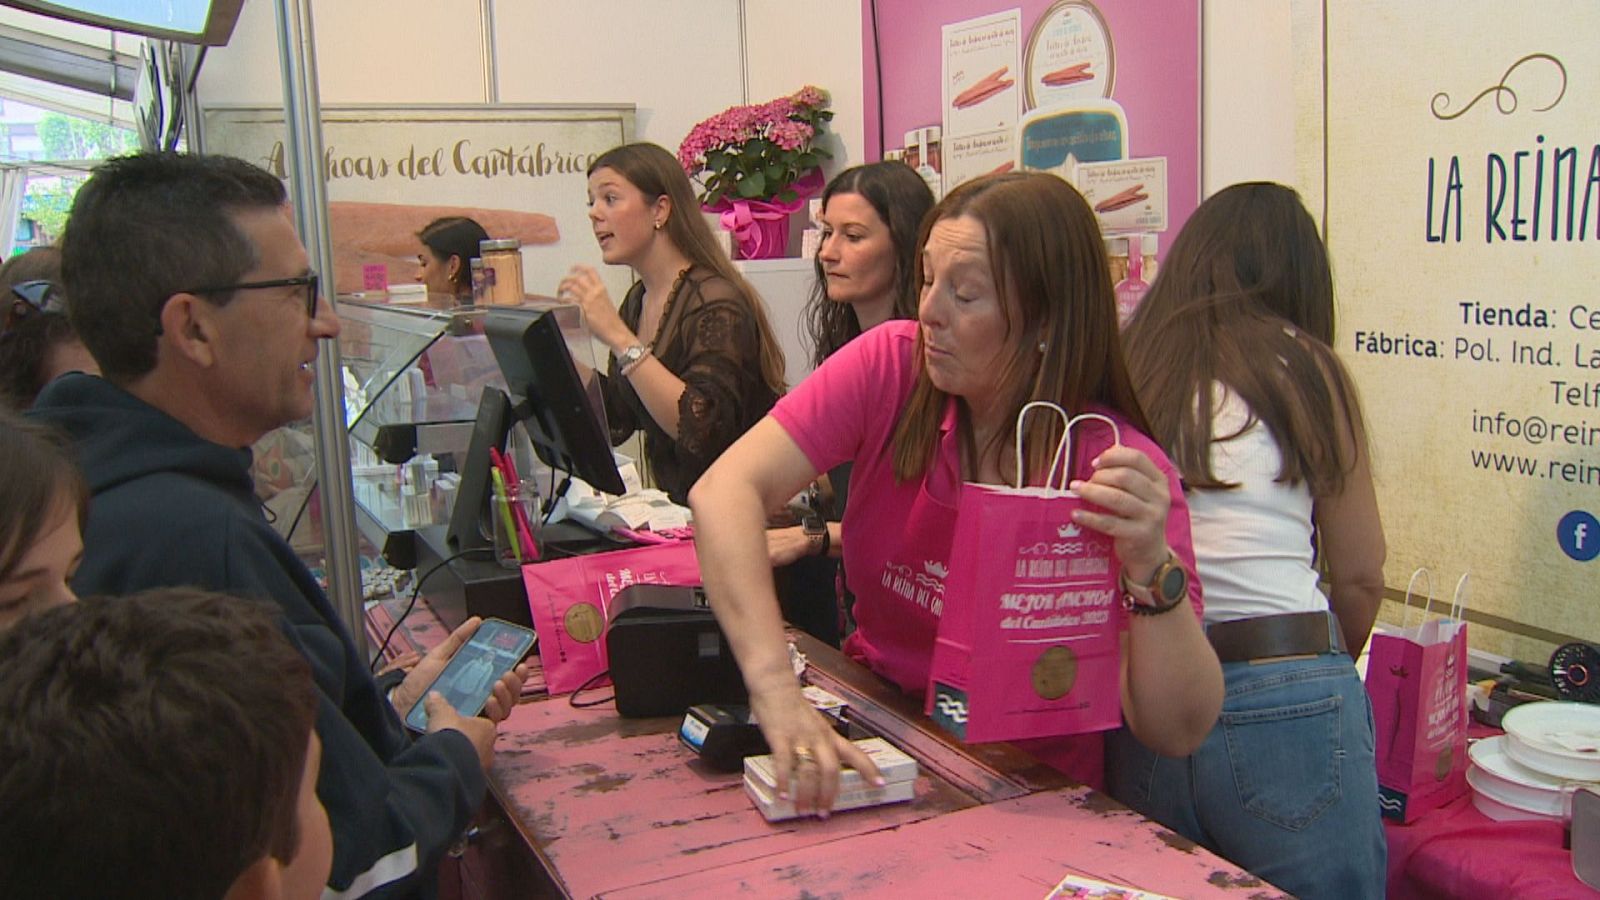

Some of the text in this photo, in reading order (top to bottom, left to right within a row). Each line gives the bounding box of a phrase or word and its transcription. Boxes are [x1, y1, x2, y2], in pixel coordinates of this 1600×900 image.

[259, 141, 389, 181] Ahoas
[397, 144, 446, 181] del
[1426, 156, 1464, 243] LA
[1459, 302, 1600, 330] Tienda: Ce
[1355, 331, 1600, 369] Fábrica: Pol. Ind. La
[1471, 450, 1600, 485] www.rein
[1000, 593, 1055, 614] MEJOR
